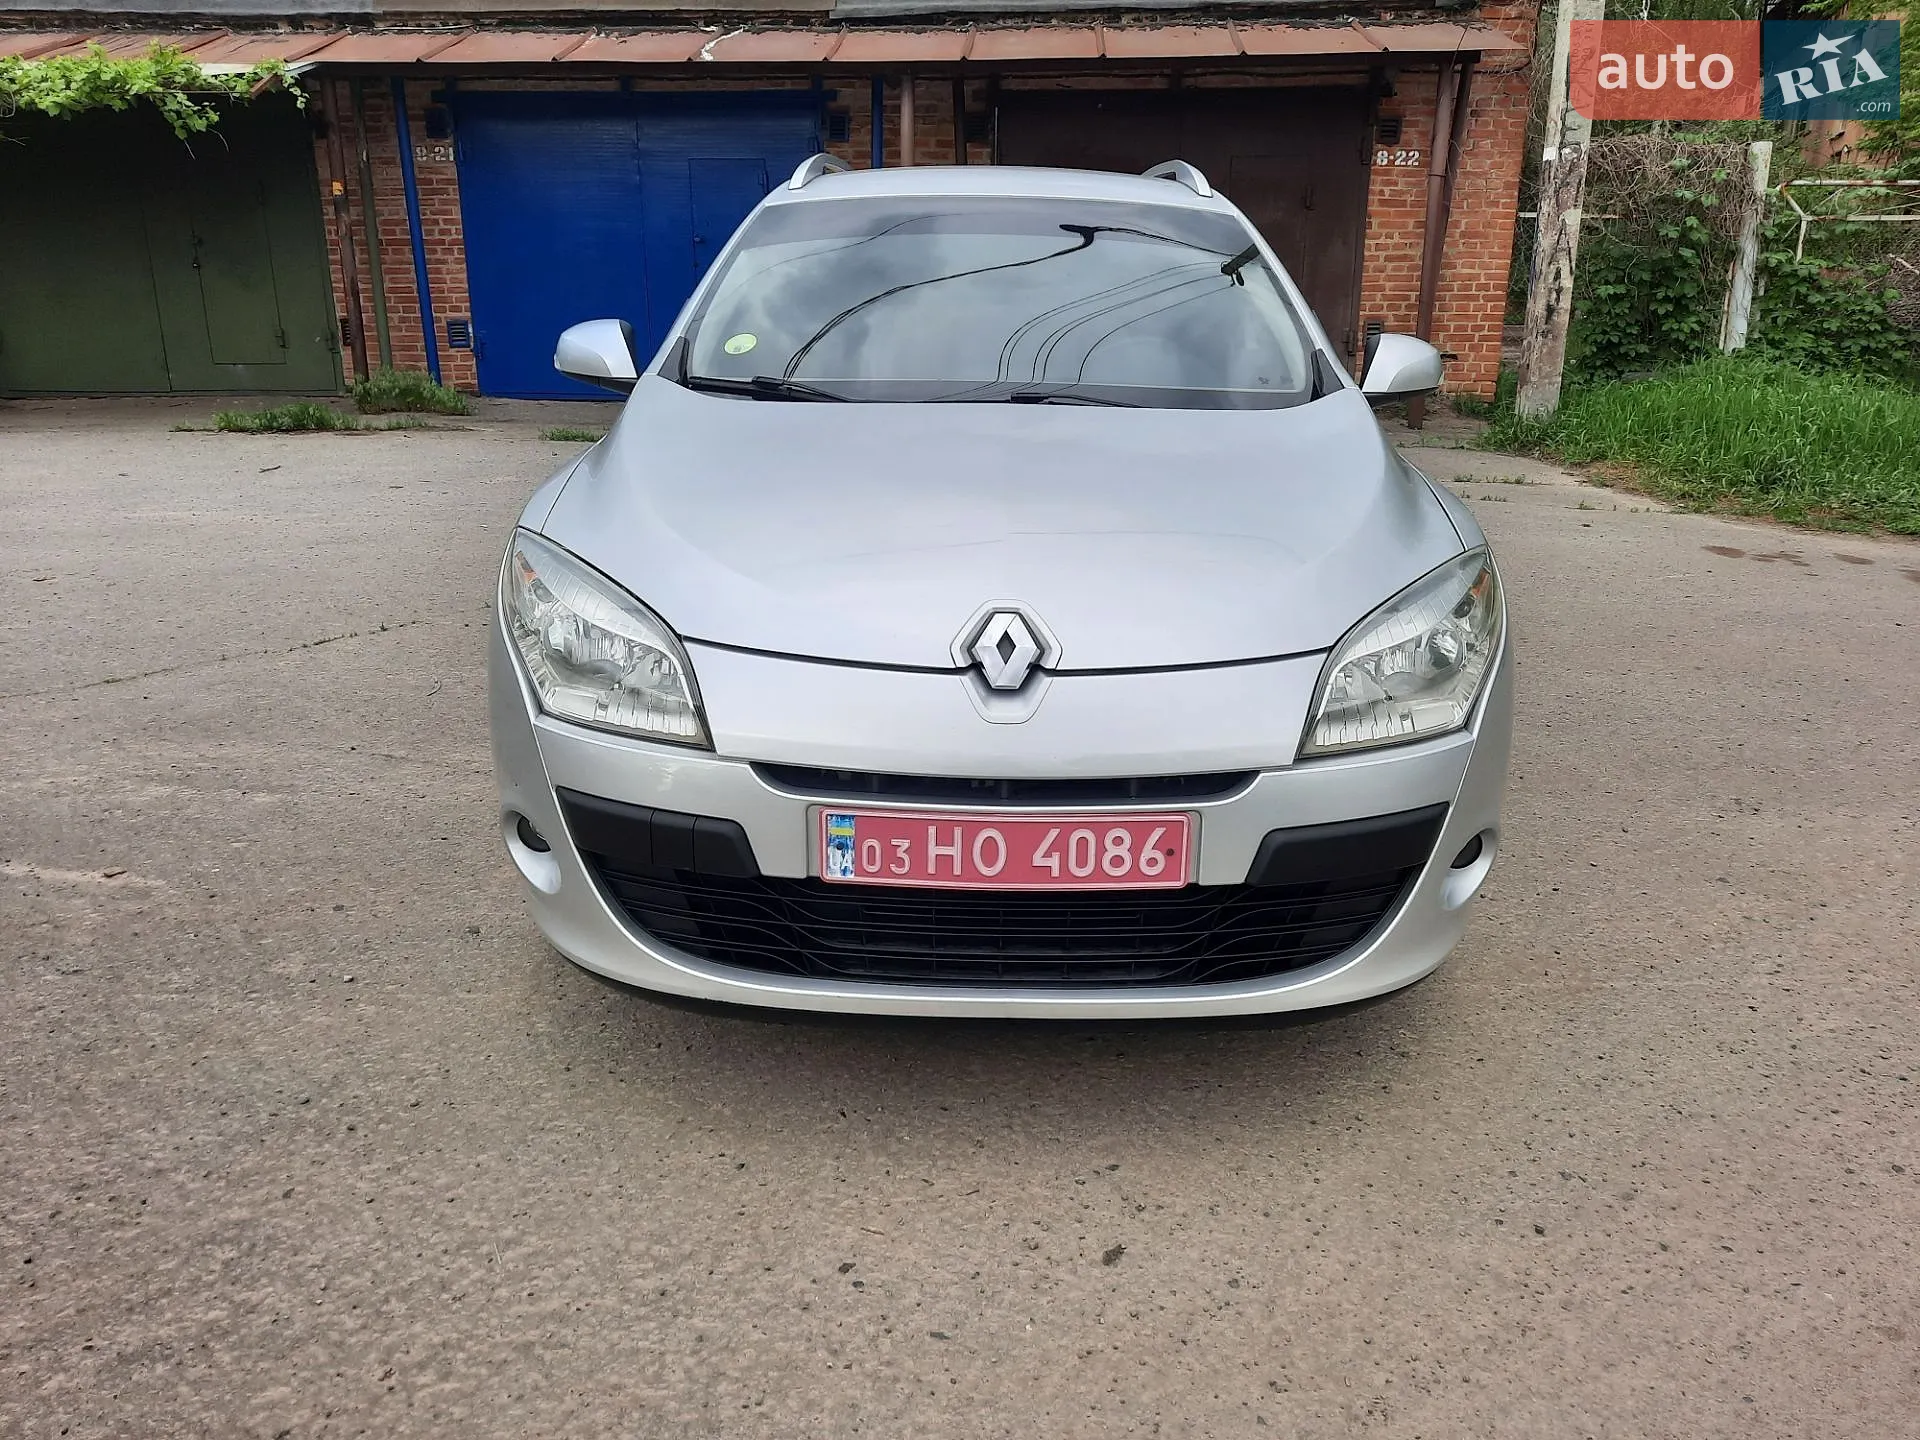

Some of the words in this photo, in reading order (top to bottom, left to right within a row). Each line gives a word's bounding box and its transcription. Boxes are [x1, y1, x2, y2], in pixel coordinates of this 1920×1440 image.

[861, 837, 912, 875] 03
[927, 825, 1008, 877] HO
[1031, 827, 1167, 877] 4086
